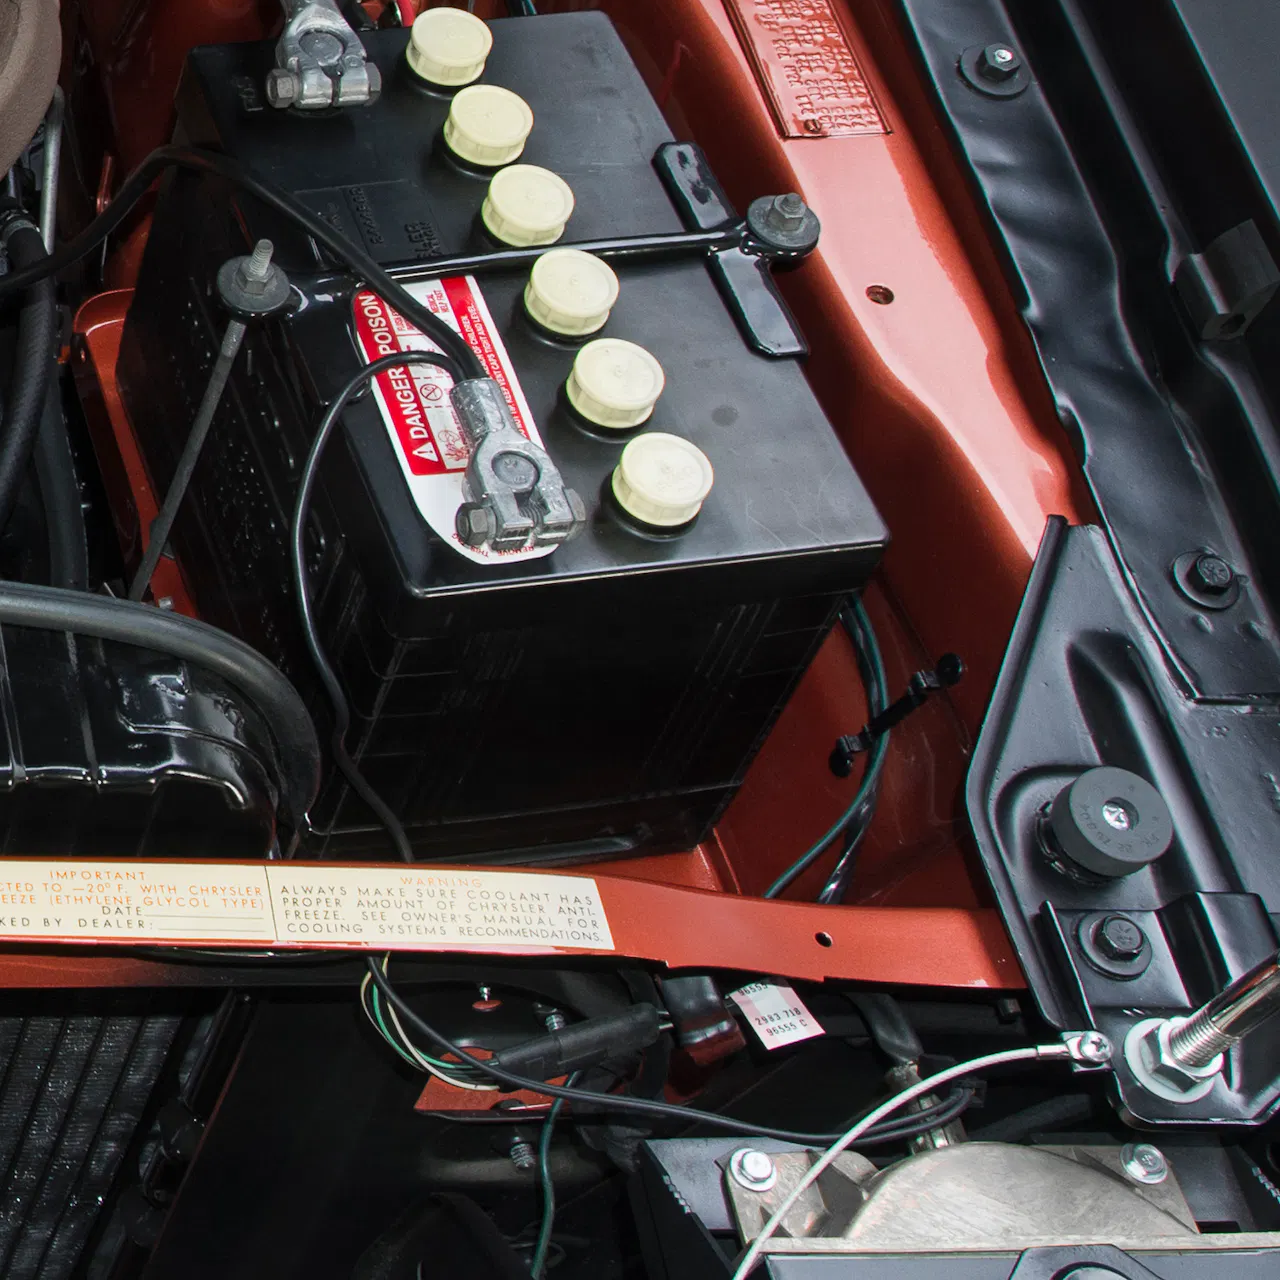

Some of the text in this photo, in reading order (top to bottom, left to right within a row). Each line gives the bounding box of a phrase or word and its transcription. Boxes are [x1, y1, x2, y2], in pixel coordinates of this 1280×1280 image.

[358, 294, 397, 355] POISON
[388, 366, 430, 440] DANGER
[49, 871, 146, 881] IMPORTANT
[400, 876, 483, 888] WARNING
[42, 882, 62, 893] TO
[140, 884, 177, 895] WITH
[189, 885, 263, 897] CHRYSLER
[281, 885, 593, 906] ALWAYS MAKE SURE COOLANT HAS
[49, 895, 133, 906] (ETHYLENE
[143, 896, 210, 908] GLYCOL
[222, 898, 265, 910] TYPE)
[102, 905, 143, 916] DATE
[283, 897, 596, 917] PROPER AMOUNT OF CHRYSLER ANTI-
[43, 918, 62, 928] BY
[78, 918, 153, 930] DEALER:
[285, 910, 599, 929] FREEZE. SEE OWNER'S MANUAL FOR
[287, 923, 604, 943] COOLING SYSTEMS RECOMMENDATIONS.
[755, 1007, 802, 1026] 2983 718
[766, 1019, 808, 1036] 96555 C
